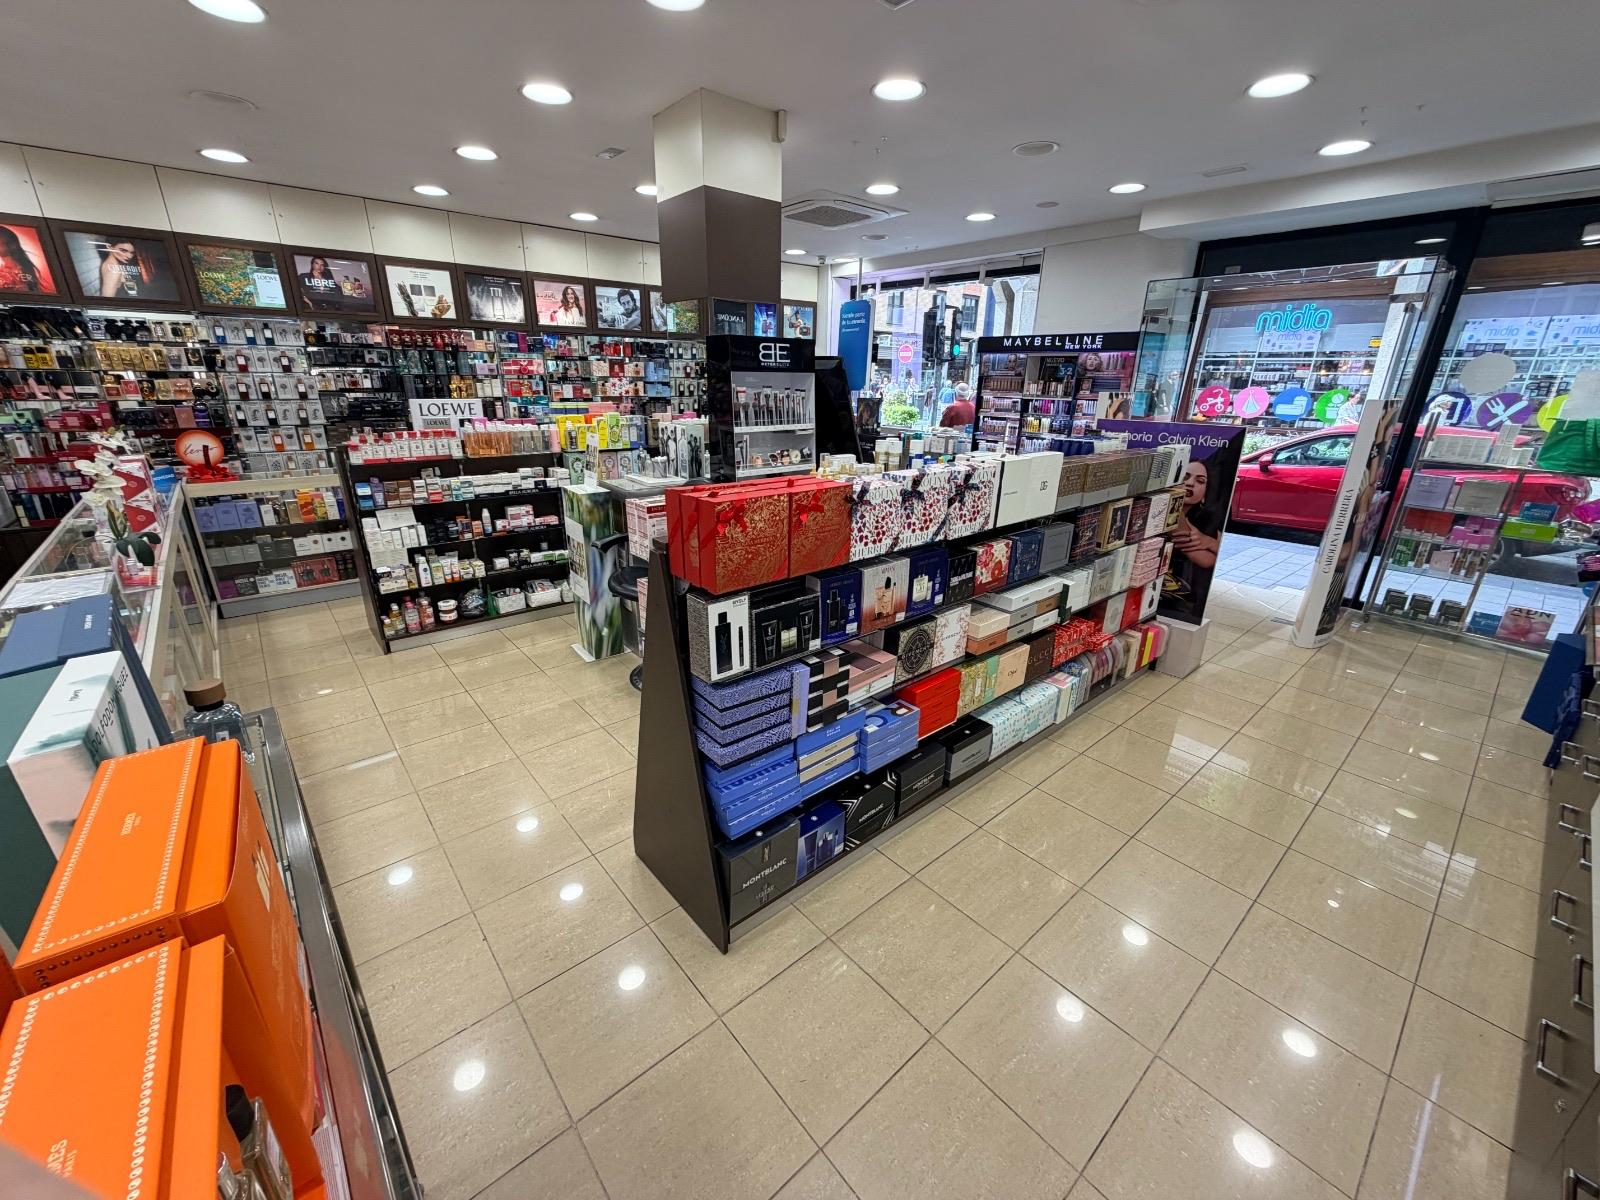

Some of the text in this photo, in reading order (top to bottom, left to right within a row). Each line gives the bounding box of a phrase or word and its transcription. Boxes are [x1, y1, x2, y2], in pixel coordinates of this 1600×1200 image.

[305, 277, 336, 288] LIBRE
[1256, 303, 1332, 332] midia
[1003, 335, 1104, 347] MAYBELLINE
[418, 402, 477, 417] LOEWE
[1158, 432, 1196, 446] Calvin
[1199, 434, 1229, 448] Klein
[1322, 488, 1355, 574] CAROLINA HERRERA
[742, 857, 787, 889] MONTBLANC
